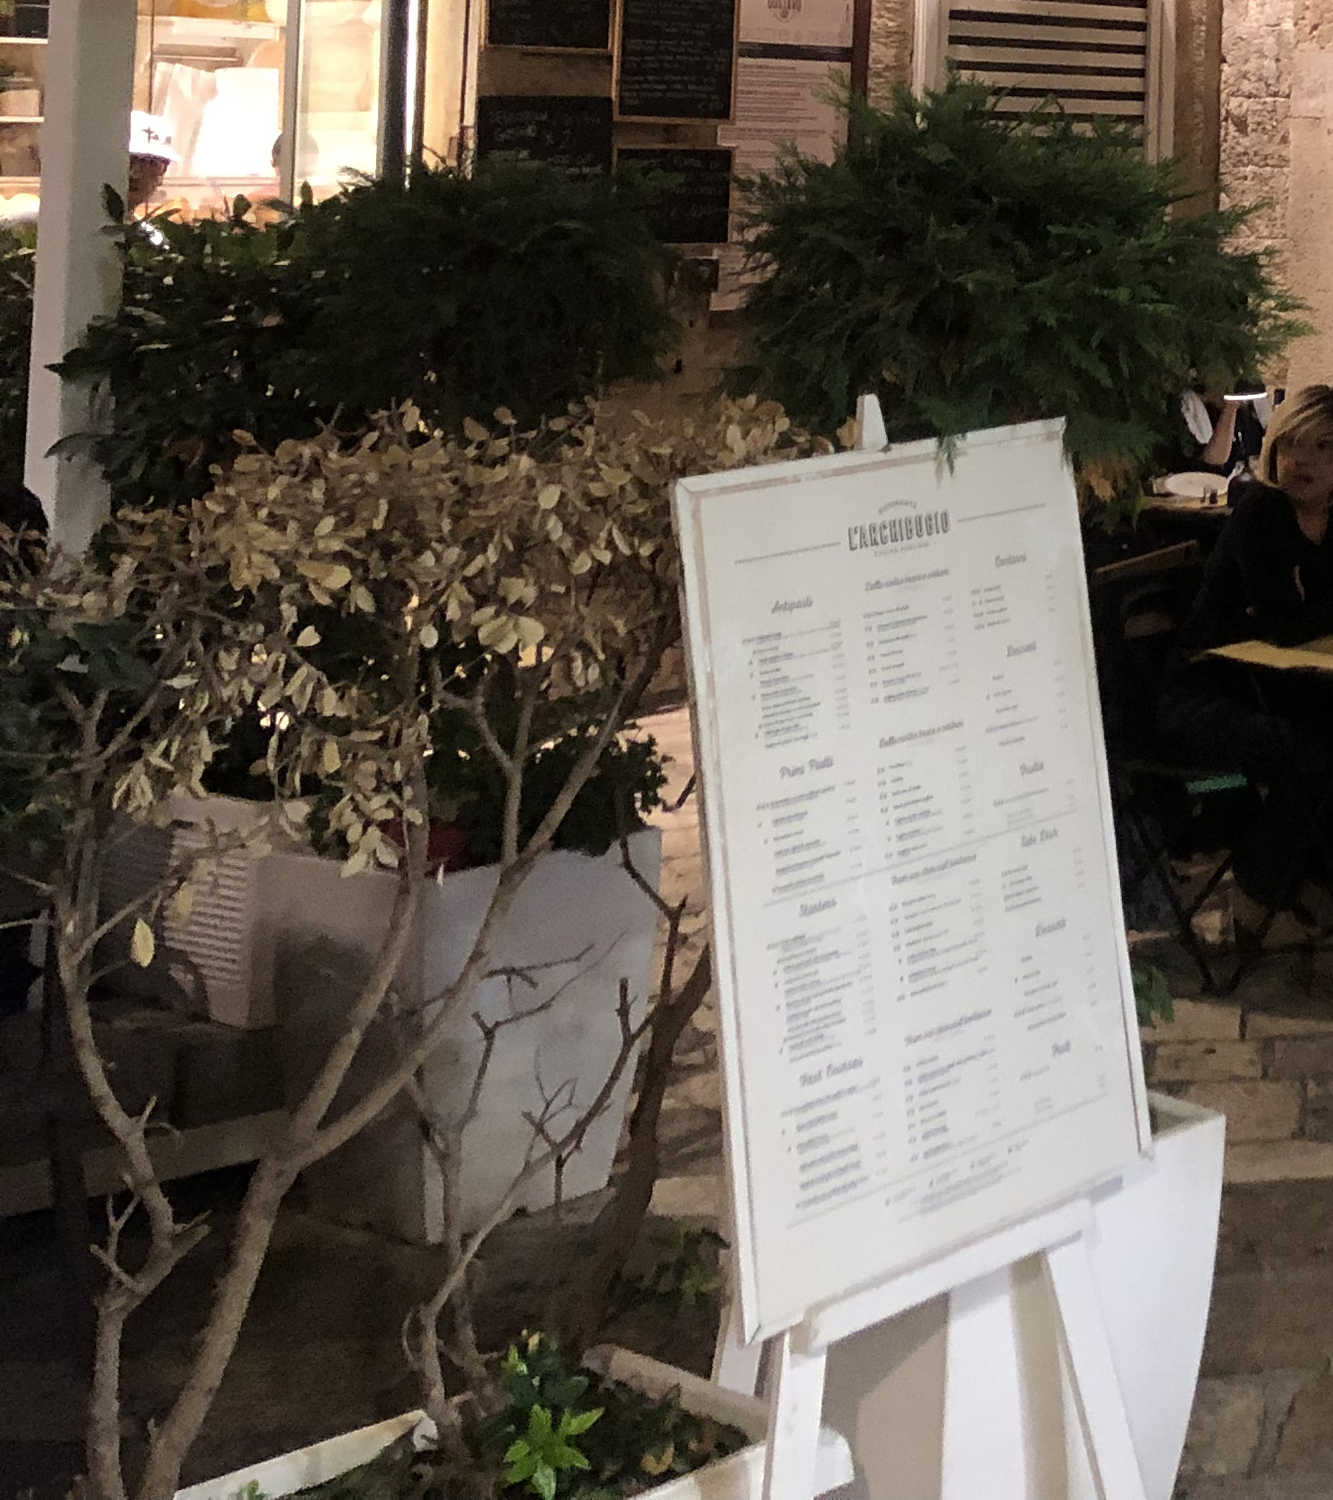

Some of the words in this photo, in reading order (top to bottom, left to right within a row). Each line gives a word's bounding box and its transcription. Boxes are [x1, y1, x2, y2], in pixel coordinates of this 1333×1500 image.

[847, 509, 951, 552] L'ARCHIBUGIO
[771, 595, 813, 615] Antipasti
[779, 764, 805, 780] Primi
[808, 755, 834, 771] Piatti
